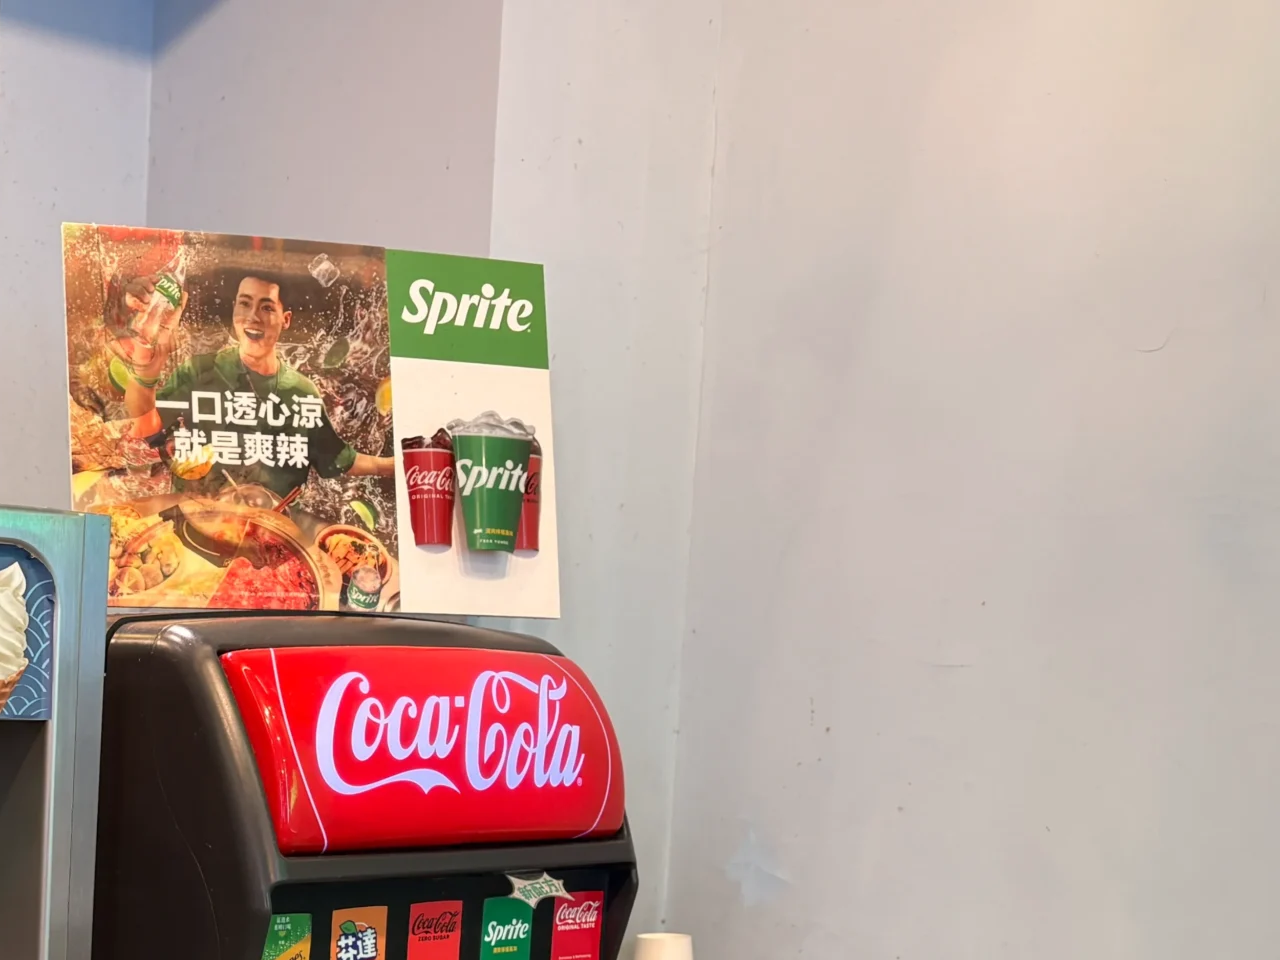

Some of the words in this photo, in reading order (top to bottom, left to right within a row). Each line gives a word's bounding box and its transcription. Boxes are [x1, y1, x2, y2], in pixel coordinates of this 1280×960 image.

[157, 275, 181, 300] prite
[401, 279, 533, 335] Sprite
[156, 391, 323, 430] 一口透心涼
[173, 430, 310, 469] 就是爽辣
[316, 670, 585, 794] Coca-Cola
[412, 910, 459, 936] Coca-Cola
[556, 901, 600, 925] Coca-Cola
[484, 918, 529, 946] Sprite
